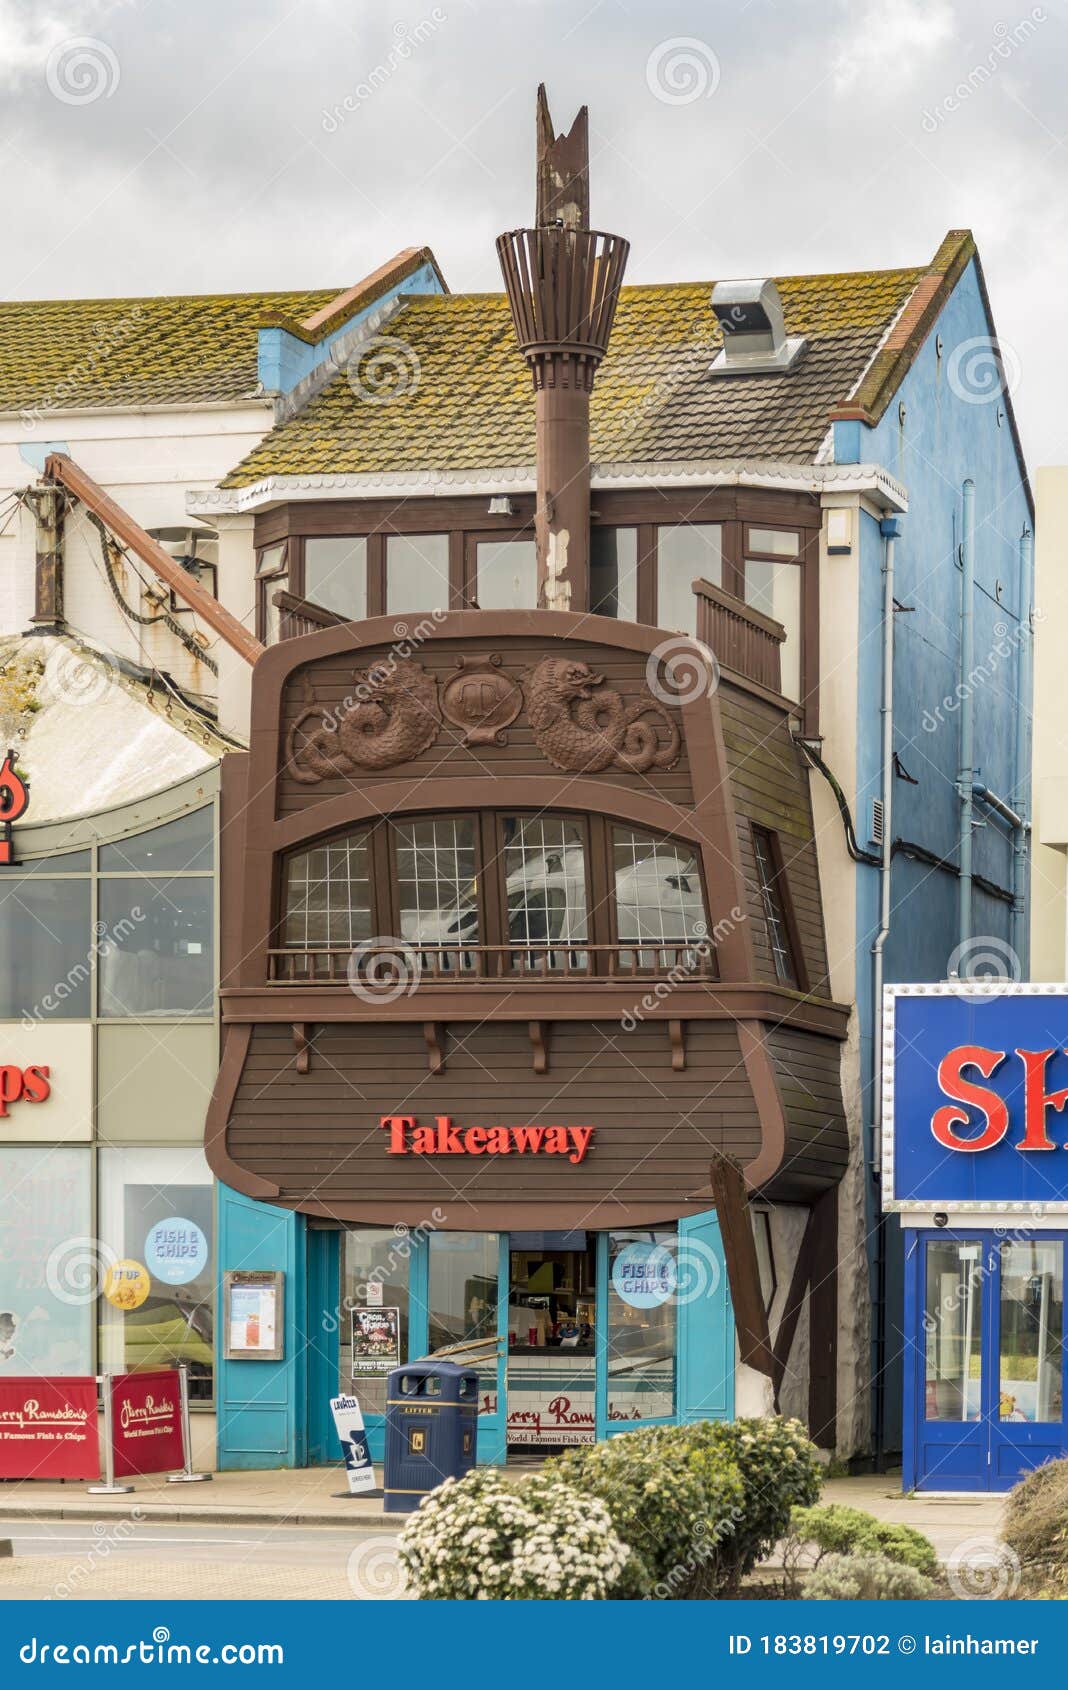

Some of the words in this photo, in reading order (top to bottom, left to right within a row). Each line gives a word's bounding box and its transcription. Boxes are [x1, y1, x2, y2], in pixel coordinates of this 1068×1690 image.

[380, 1116, 595, 1164] Takeaway
[154, 1229, 186, 1243] FISH
[156, 1245, 199, 1258] CHIPS
[620, 1263, 656, 1279] FISH
[623, 1280, 669, 1294] CHIPS
[24, 1399, 87, 1421] Ramsden's
[4, 1432, 36, 1440] Famous
[37, 1432, 54, 1440] Fish
[64, 1432, 87, 1442] Chips
[530, 1434, 561, 1443] Famous
[562, 1435, 579, 1443] Fish
[581, 1435, 589, 1443] &
